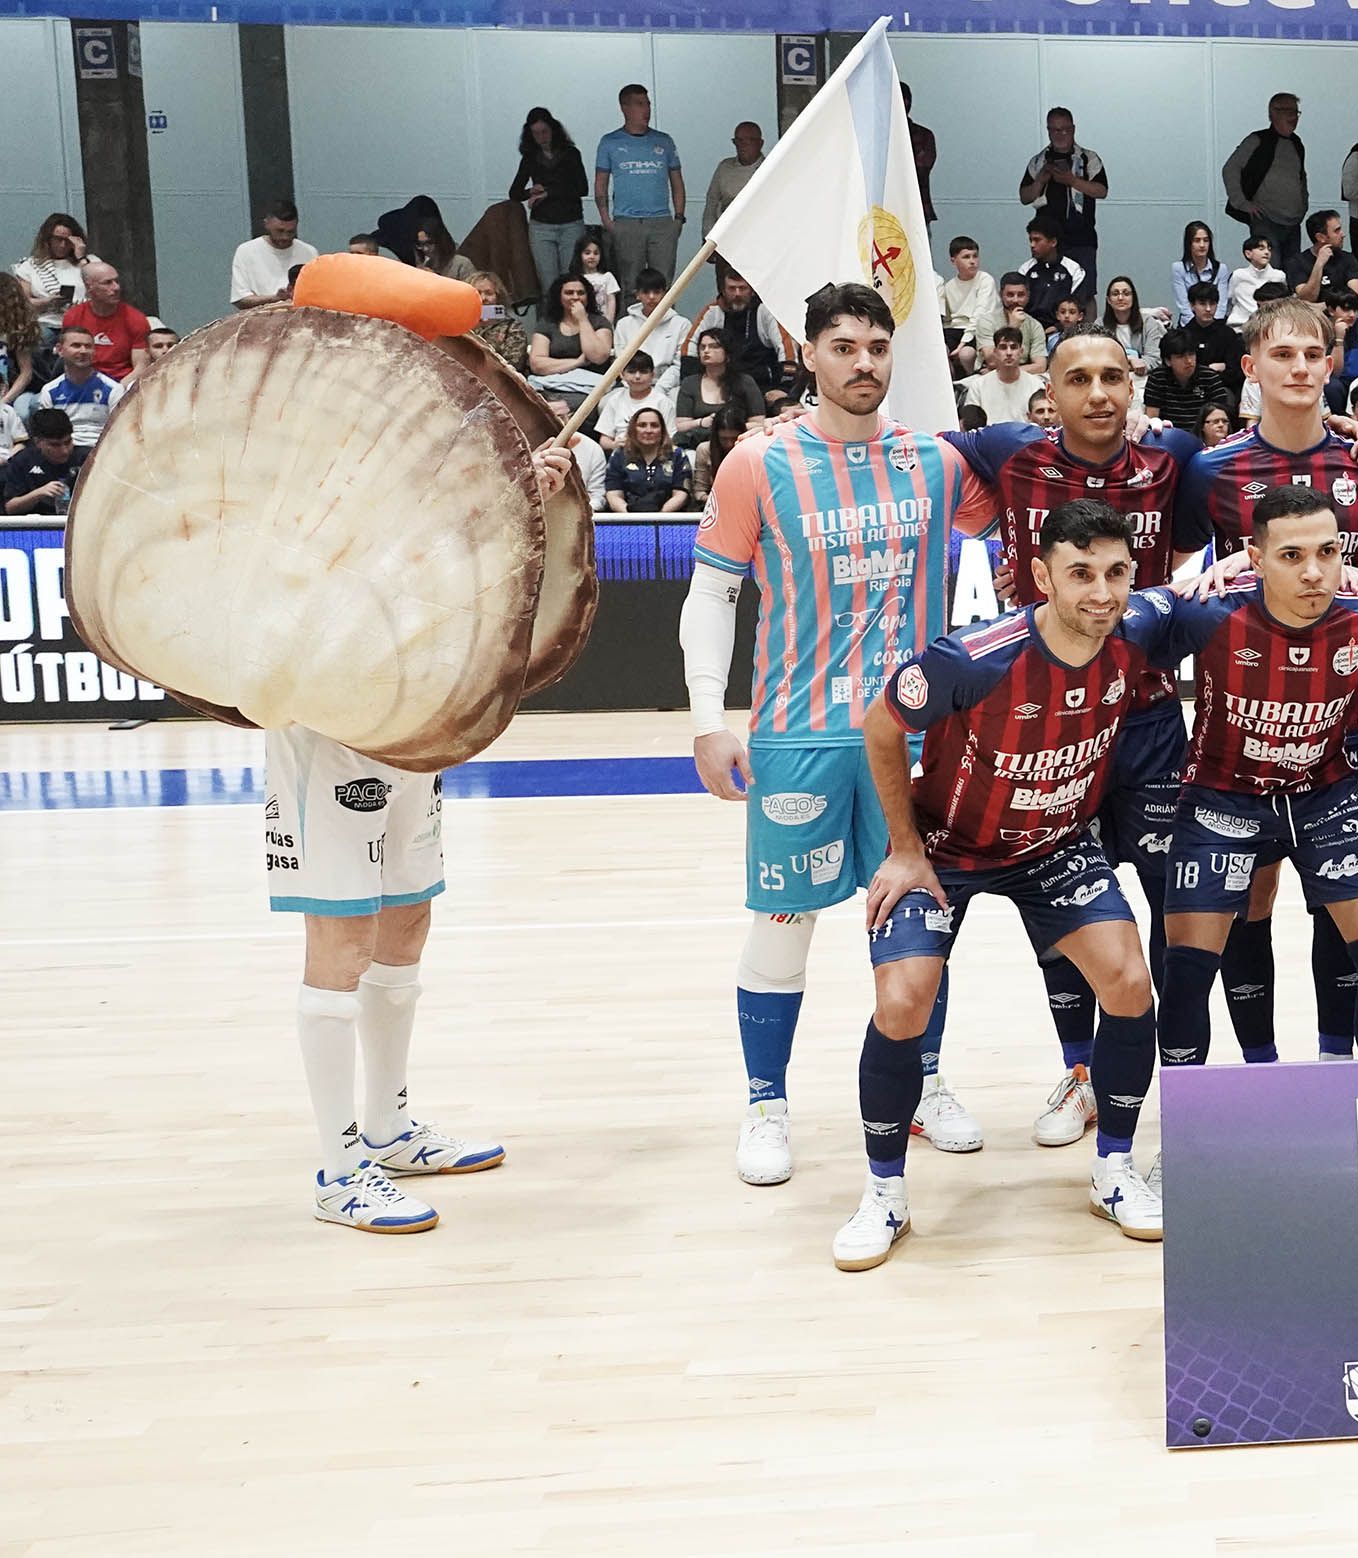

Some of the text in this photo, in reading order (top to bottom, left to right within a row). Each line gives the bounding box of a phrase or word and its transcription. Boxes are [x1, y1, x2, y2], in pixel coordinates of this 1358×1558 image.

[84, 40, 108, 64] C
[787, 47, 810, 71] C
[797, 497, 933, 538] TUBANOR
[808, 521, 928, 552] INSTALACIONES
[832, 548, 915, 579] BigMat
[1235, 659, 1259, 668] umbro
[1224, 689, 1355, 724] TUBANOR
[1243, 736, 1329, 764] BigMat
[789, 843, 841, 875] USC
[758, 861, 785, 891] 25
[1175, 861, 1200, 889] 18
